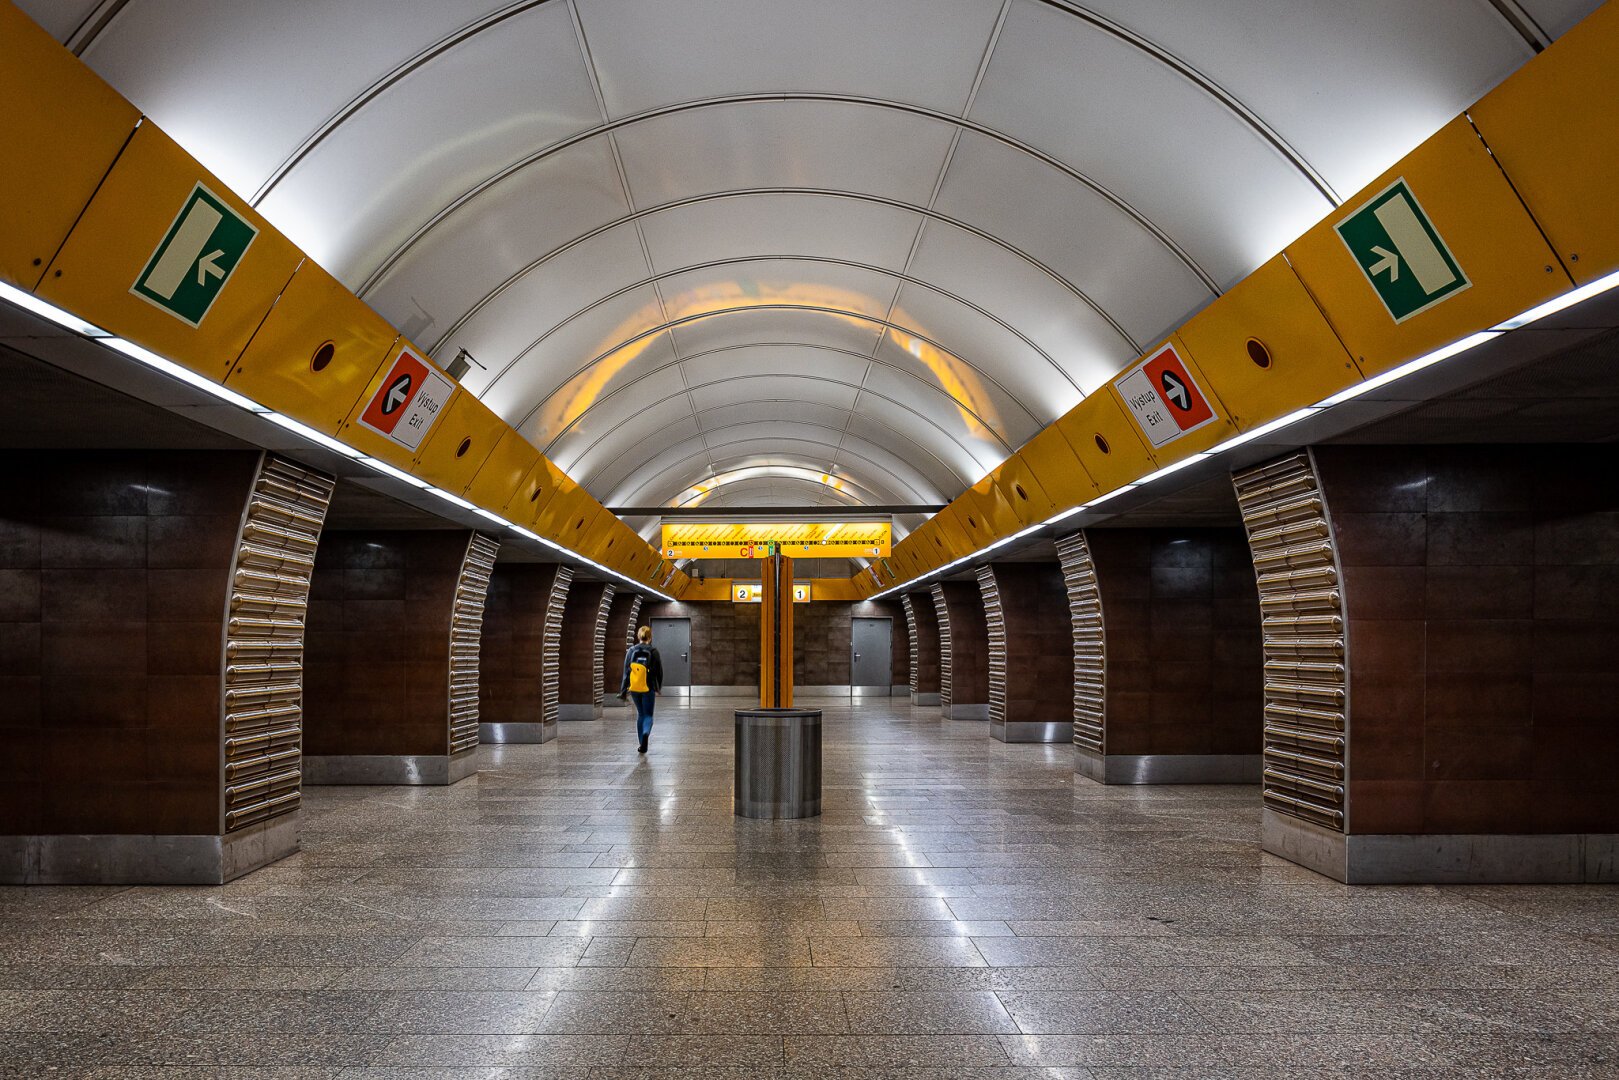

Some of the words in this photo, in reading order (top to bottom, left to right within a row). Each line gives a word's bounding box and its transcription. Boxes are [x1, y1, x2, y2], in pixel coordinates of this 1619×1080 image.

[417, 391, 439, 415] Výstup
[1130, 391, 1156, 411] Výstup
[408, 414, 424, 430] Exit
[1146, 411, 1163, 426] Exit
[740, 548, 748, 557] C
[740, 590, 746, 598] 2
[796, 590, 802, 598] 1
